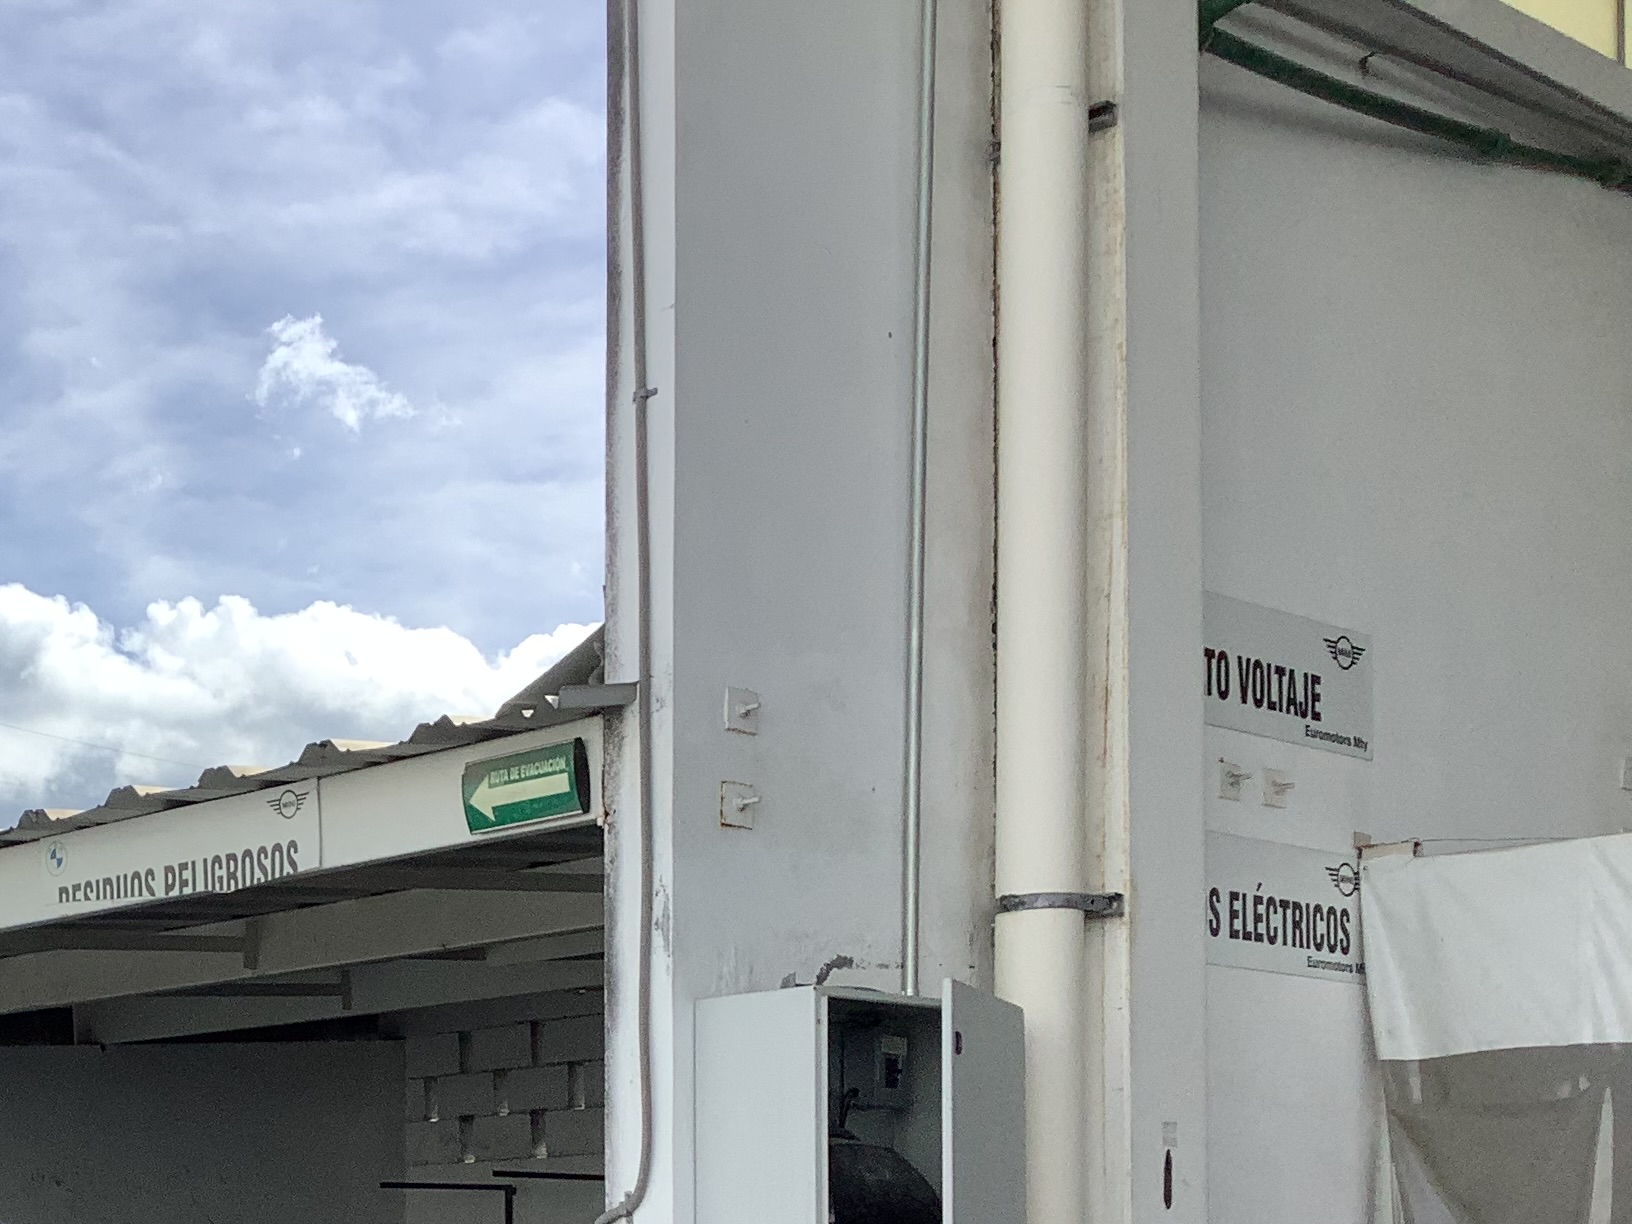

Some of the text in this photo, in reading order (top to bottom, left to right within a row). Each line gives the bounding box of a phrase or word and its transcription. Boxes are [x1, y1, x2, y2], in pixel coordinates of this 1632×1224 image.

[1237, 655, 1321, 722] VOLTAJE
[1305, 724, 1351, 747] Euromotors
[489, 768, 509, 784] RUTA
[509, 764, 520, 780] DE
[163, 839, 298, 896] PELIGROSOS
[1229, 882, 1351, 956] ELÉCTRICOS
